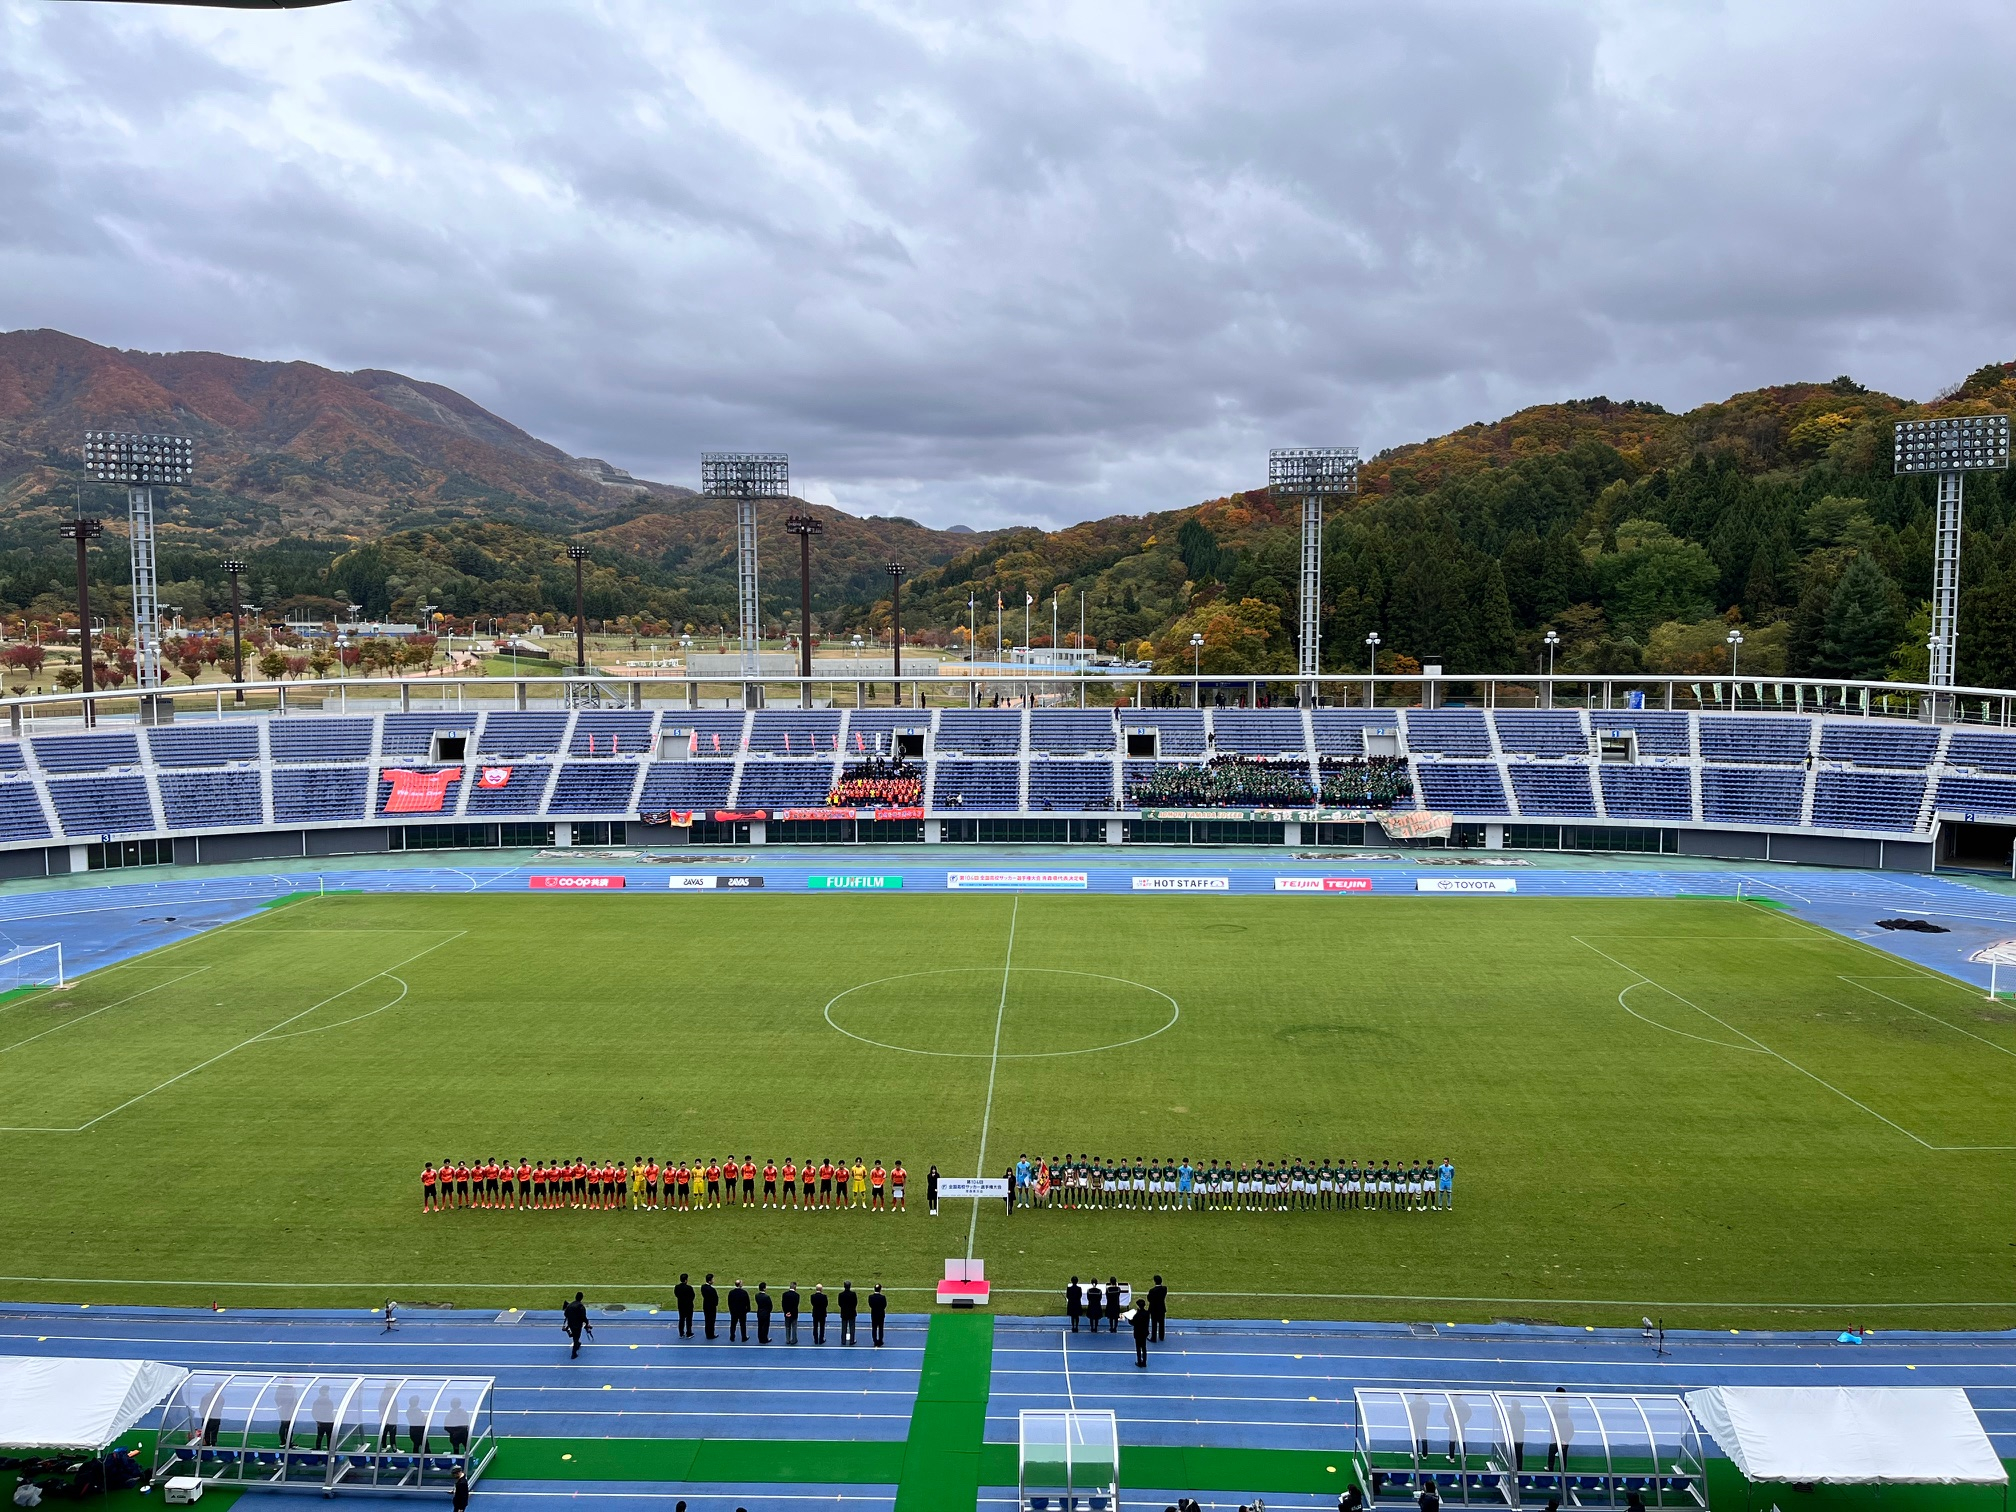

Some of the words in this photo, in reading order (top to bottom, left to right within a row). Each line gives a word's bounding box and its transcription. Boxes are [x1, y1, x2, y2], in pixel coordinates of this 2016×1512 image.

[1186, 811, 1217, 819] YAMADA
[1966, 813, 1973, 821] 2
[1177, 880, 1209, 888] STAFF
[1280, 880, 1320, 888] TEIJIN
[1326, 881, 1366, 889] TEIJIN
[1454, 881, 1496, 889] TOYOTA
